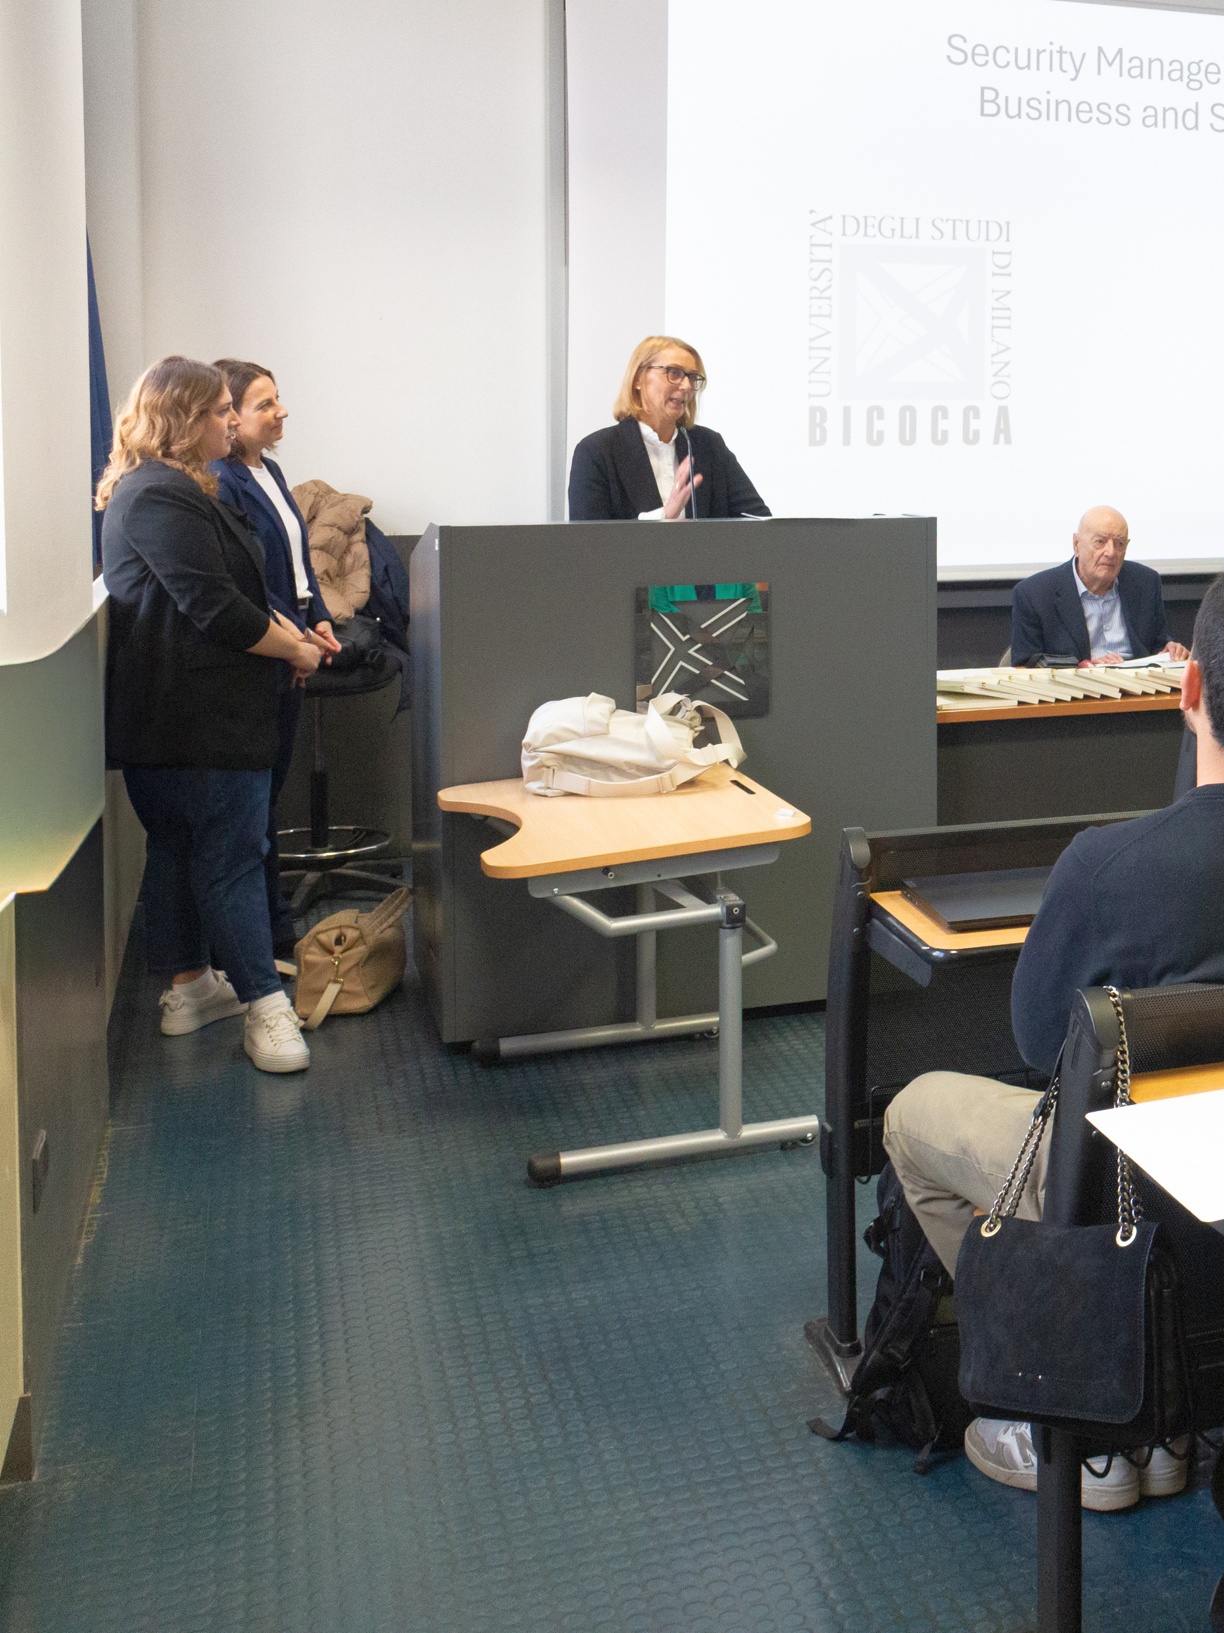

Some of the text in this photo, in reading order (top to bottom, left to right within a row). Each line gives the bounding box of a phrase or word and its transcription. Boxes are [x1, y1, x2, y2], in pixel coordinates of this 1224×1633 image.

[946, 33, 1087, 81] Security
[979, 86, 1132, 127] Business
[1141, 102, 1200, 131] and
[841, 214, 1011, 243] DEGLI STUDI
[990, 250, 1013, 400] DI MILANO
[808, 405, 1013, 447] BICOCCA
